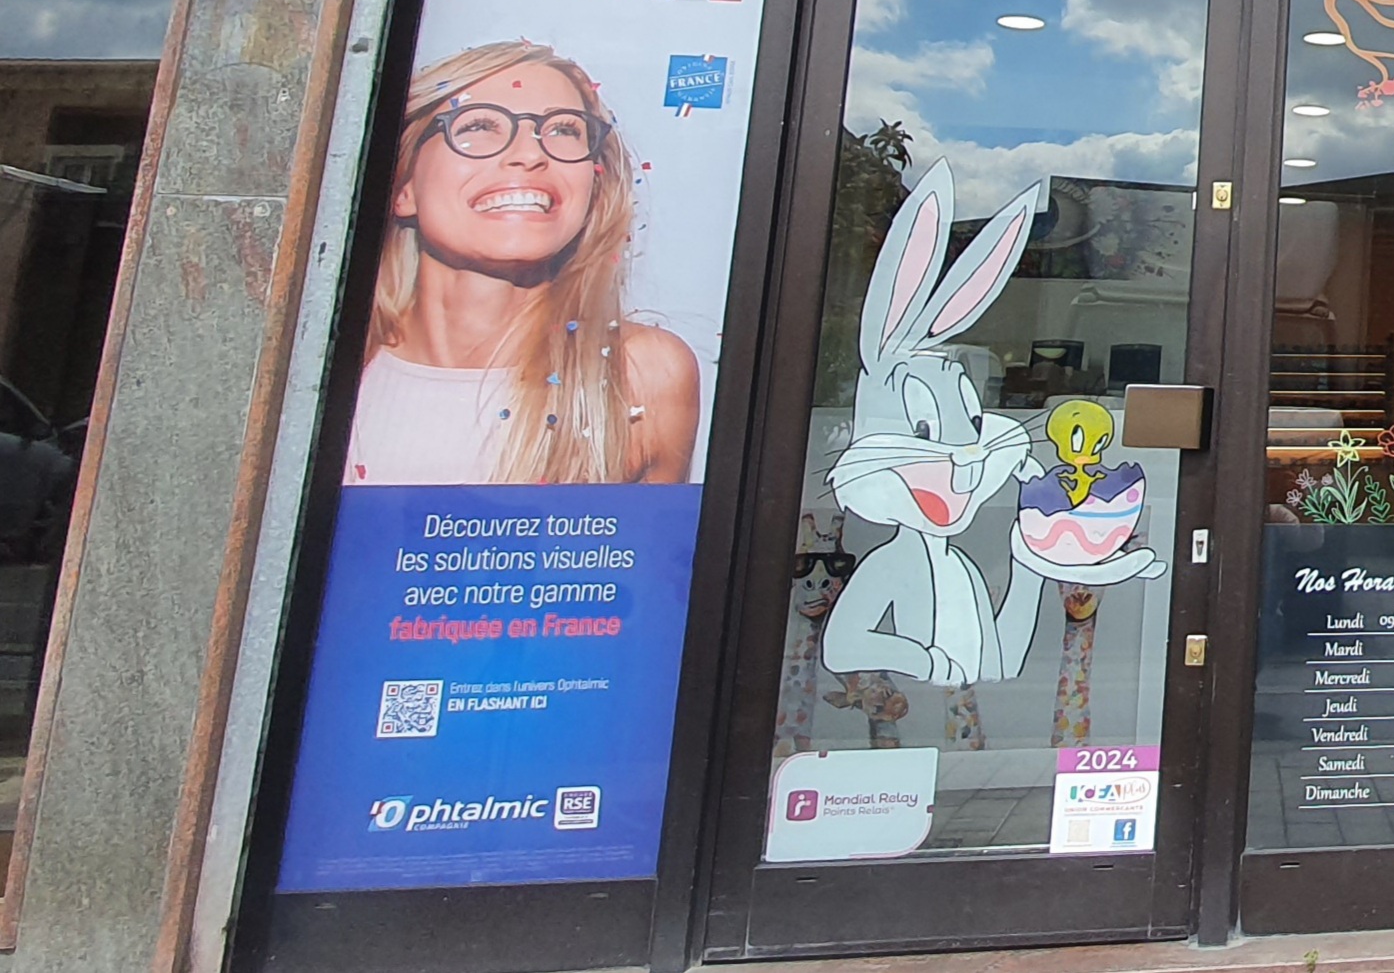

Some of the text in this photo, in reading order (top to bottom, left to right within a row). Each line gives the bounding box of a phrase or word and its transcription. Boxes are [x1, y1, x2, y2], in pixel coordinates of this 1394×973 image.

[669, 73, 720, 88] FRANCE
[424, 514, 617, 537] Découvrez toutes
[396, 545, 634, 571] les solutions visuelles
[1295, 568, 1336, 593] Nos
[404, 583, 616, 608] avec notre gamme
[390, 613, 621, 644] fabriquée en France
[1327, 612, 1364, 629] Lundi
[1325, 640, 1363, 657] Mardi
[1315, 668, 1371, 685] Mercredi
[450, 683, 483, 694] Entrez
[486, 682, 511, 693] dans
[447, 695, 547, 711] EN FLASHANT ICI
[1322, 696, 1358, 717] Jeudi
[1312, 725, 1368, 742] Vendredi
[1075, 749, 1138, 771] 2024
[1318, 754, 1365, 771] Samedi
[824, 792, 918, 807] Mondial Relay
[1305, 782, 1371, 801] Dimanche
[563, 797, 593, 810] RSE
[823, 807, 856, 817] Points
